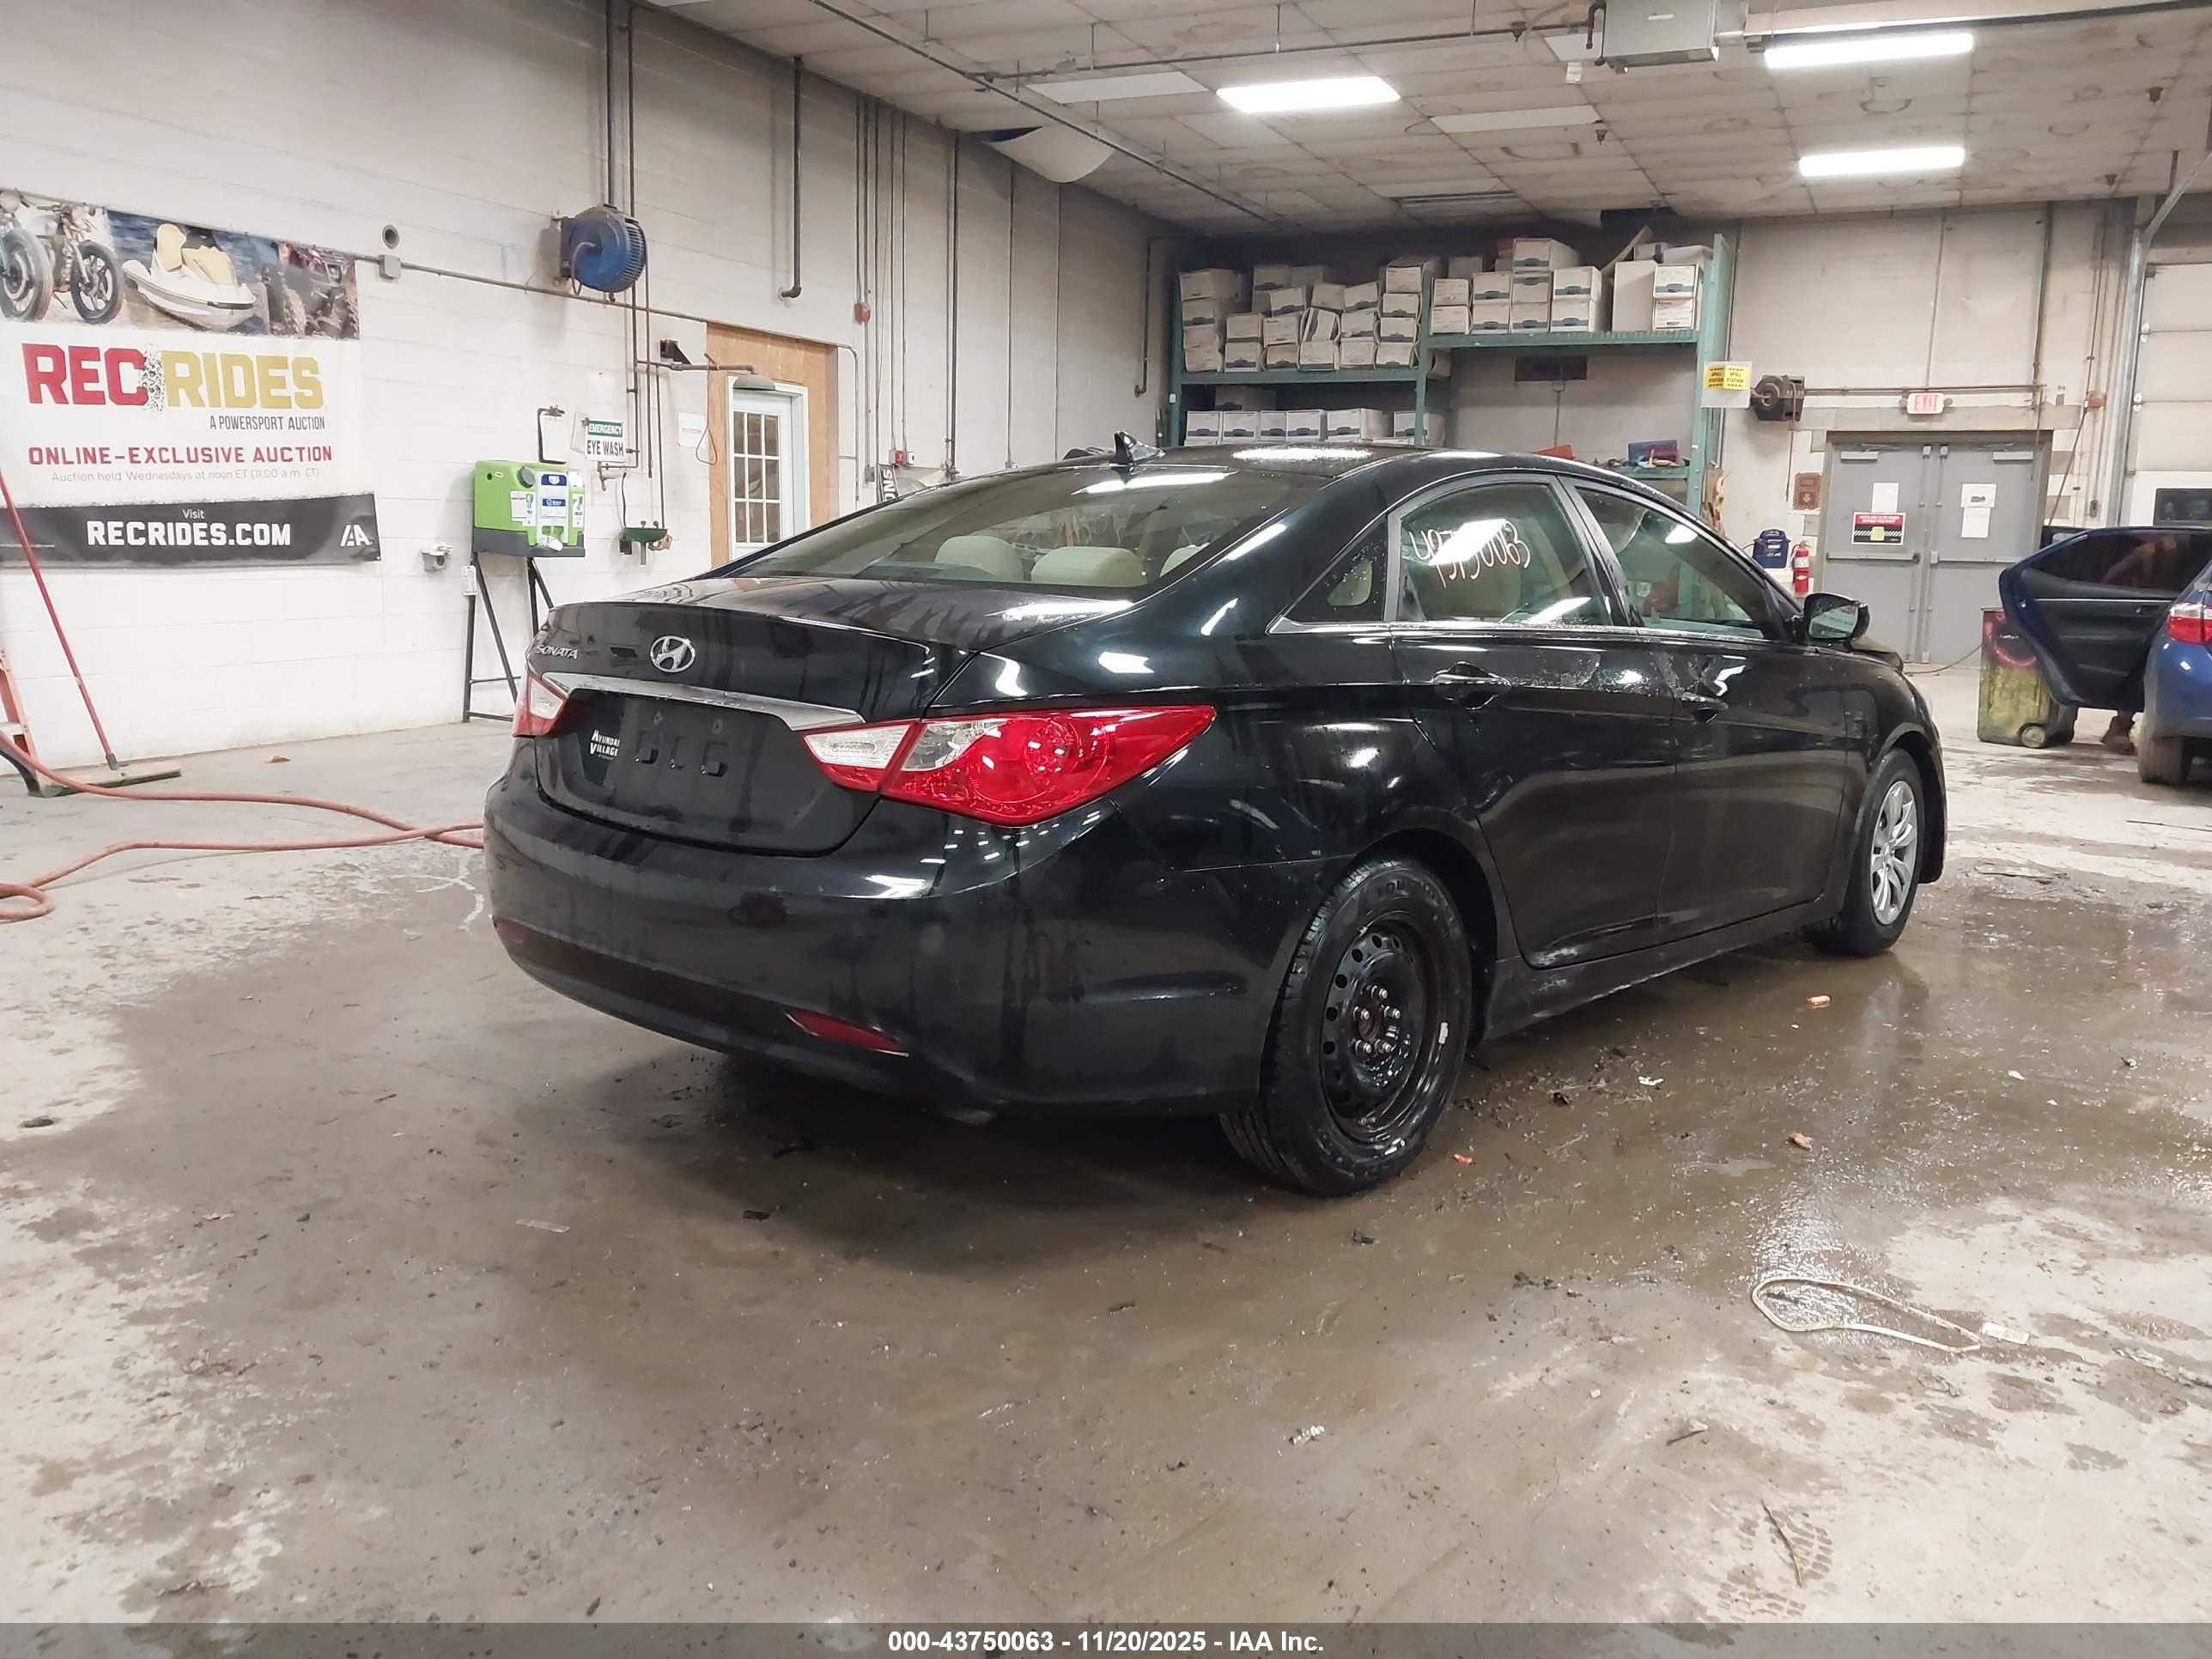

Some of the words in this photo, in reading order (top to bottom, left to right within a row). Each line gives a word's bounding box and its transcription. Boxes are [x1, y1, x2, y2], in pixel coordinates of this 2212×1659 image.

[22, 343, 149, 406] REC
[161, 350, 325, 410] RIDES
[1914, 394, 1939, 411] EXIT
[210, 415, 216, 429] A
[219, 415, 283, 430] POWERSPORT
[289, 416, 325, 430] AUCTION
[588, 422, 622, 435] EMERGENCY
[28, 447, 245, 465] ONLINE-EXCLUSIVE
[252, 446, 332, 464] AUCTION
[587, 440, 600, 455] EYE
[603, 441, 623, 457] WASH
[52, 471, 94, 482] Auction
[98, 471, 122, 481] held
[126, 471, 192, 482] Wednesdays
[196, 471, 206, 480] at
[235, 469, 248, 478] ET
[182, 508, 205, 520] Visit
[87, 520, 292, 547] RECRIDES.COM
[535, 645, 578, 659] SONATA
[592, 729, 620, 747] HYUNDAI
[590, 742, 619, 756] VILLAGE
